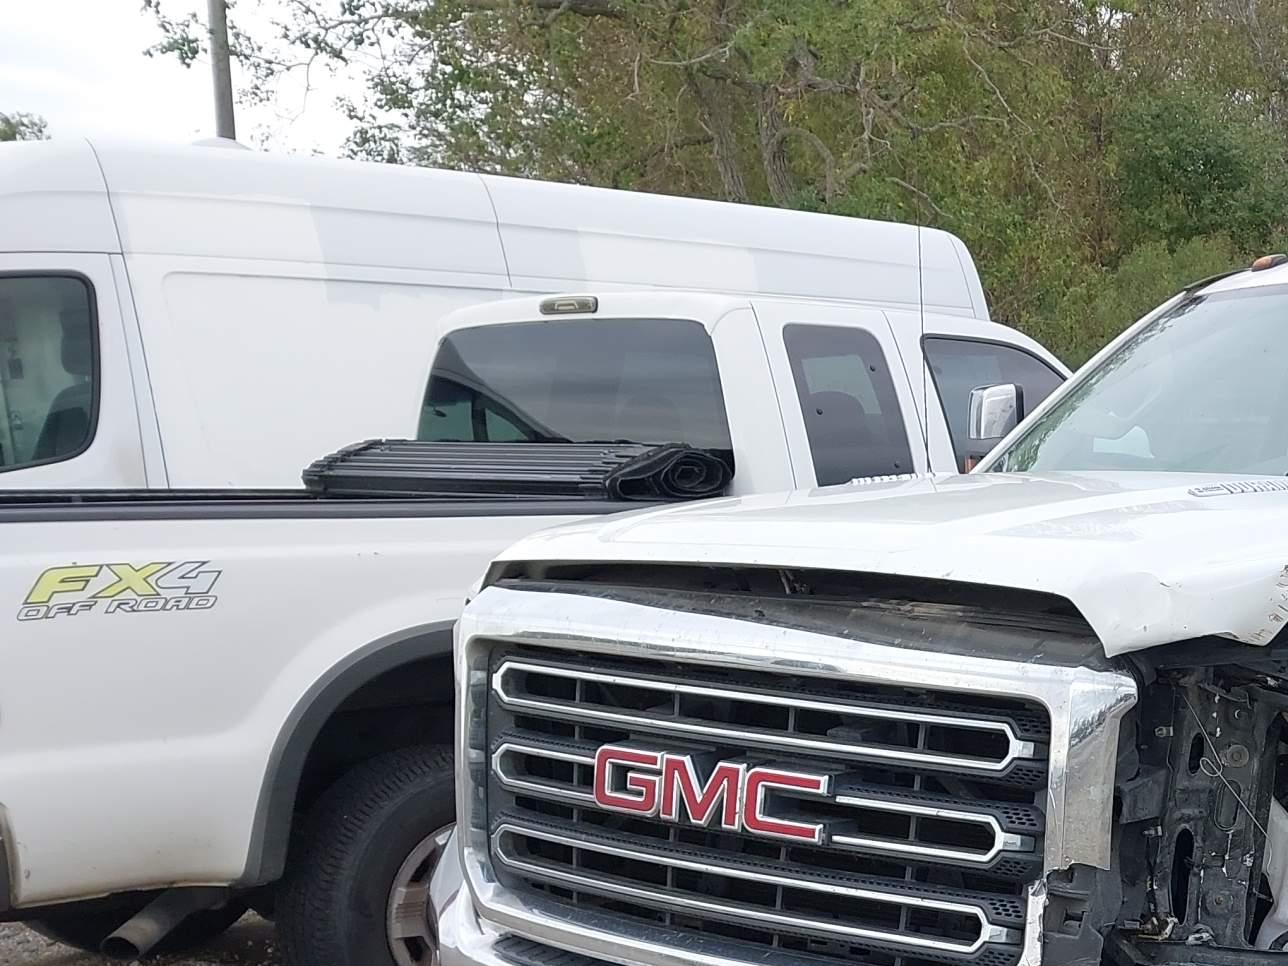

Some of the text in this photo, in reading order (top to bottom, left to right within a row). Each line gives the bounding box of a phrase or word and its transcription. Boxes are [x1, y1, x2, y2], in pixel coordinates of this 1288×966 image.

[22, 560, 223, 605] FX4
[17, 594, 218, 621] OFF ROAD
[593, 744, 830, 844] GMC
